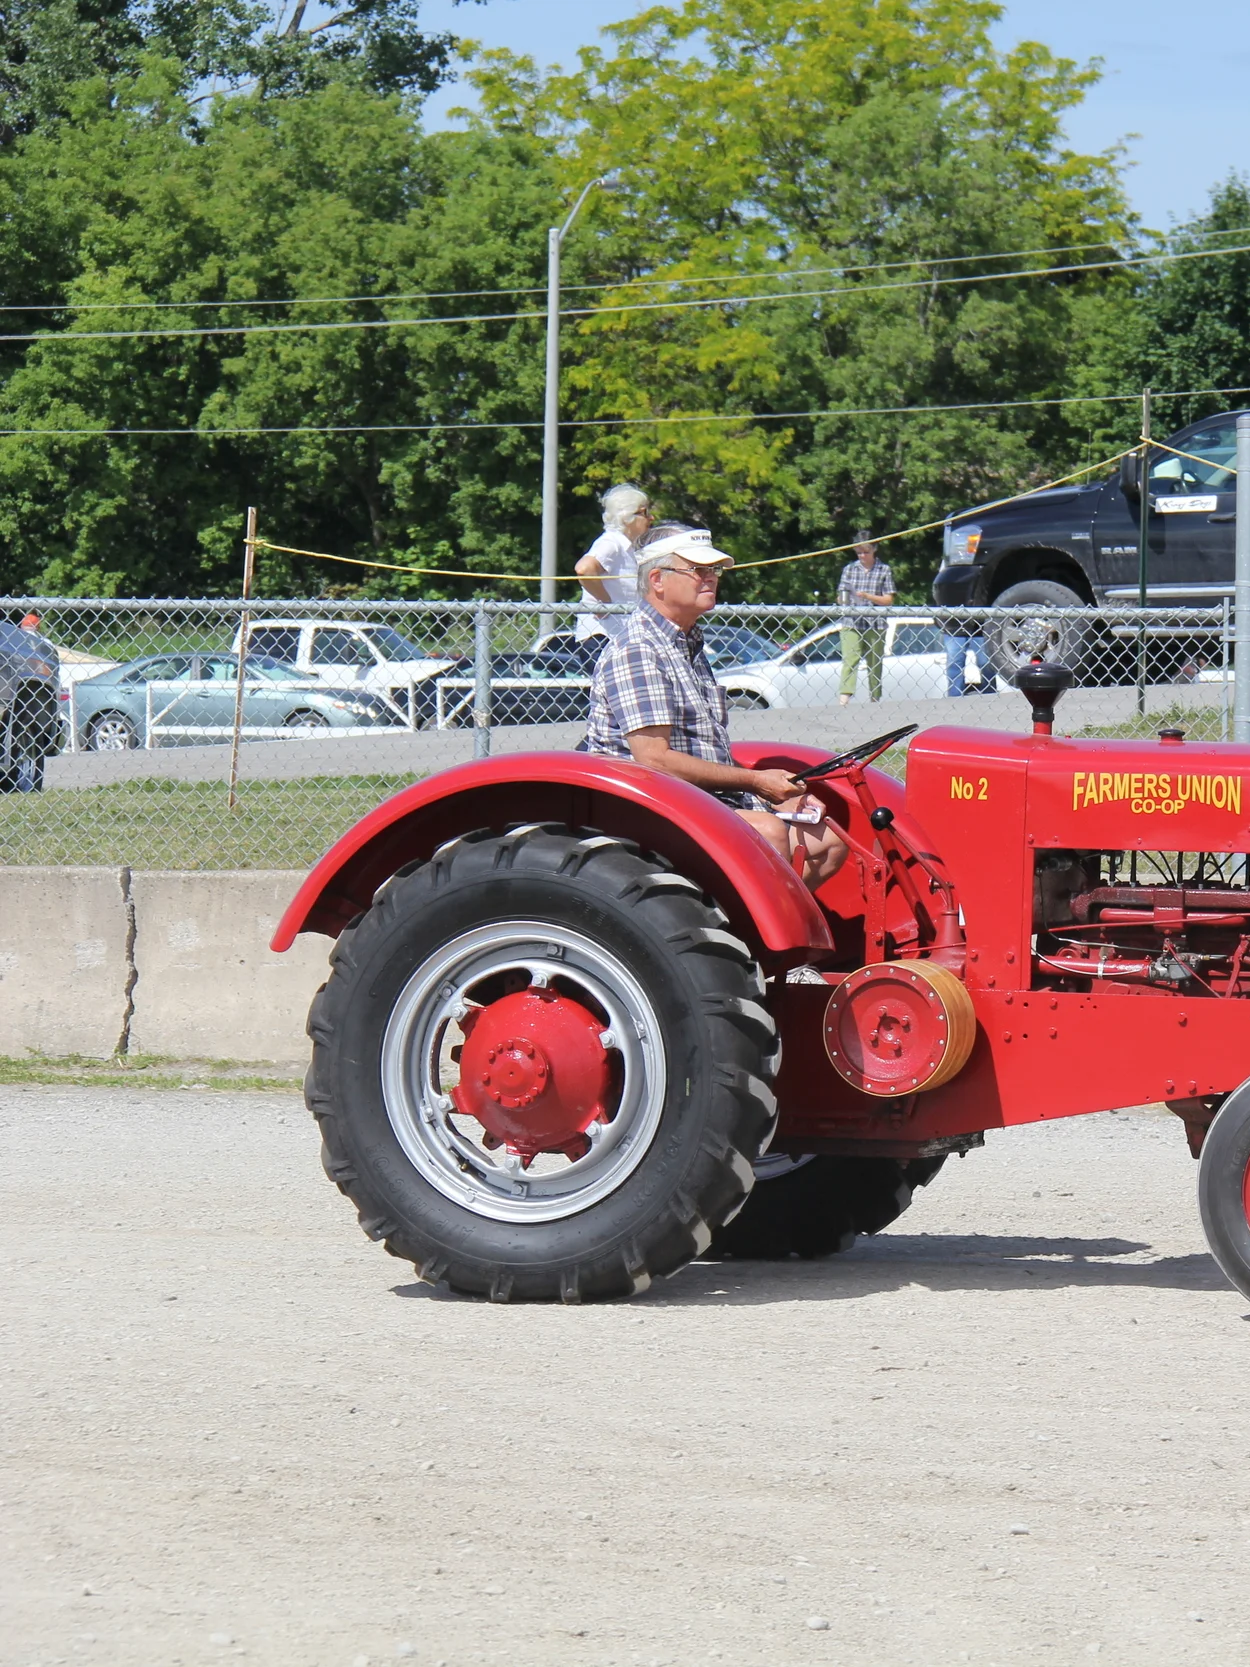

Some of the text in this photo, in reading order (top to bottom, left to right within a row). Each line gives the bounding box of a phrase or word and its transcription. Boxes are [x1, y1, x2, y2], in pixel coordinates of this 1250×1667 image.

[950, 776, 988, 800] No 2
[1073, 771, 1242, 815] FARMERS UNION
[1131, 798, 1186, 815] CO-OP
